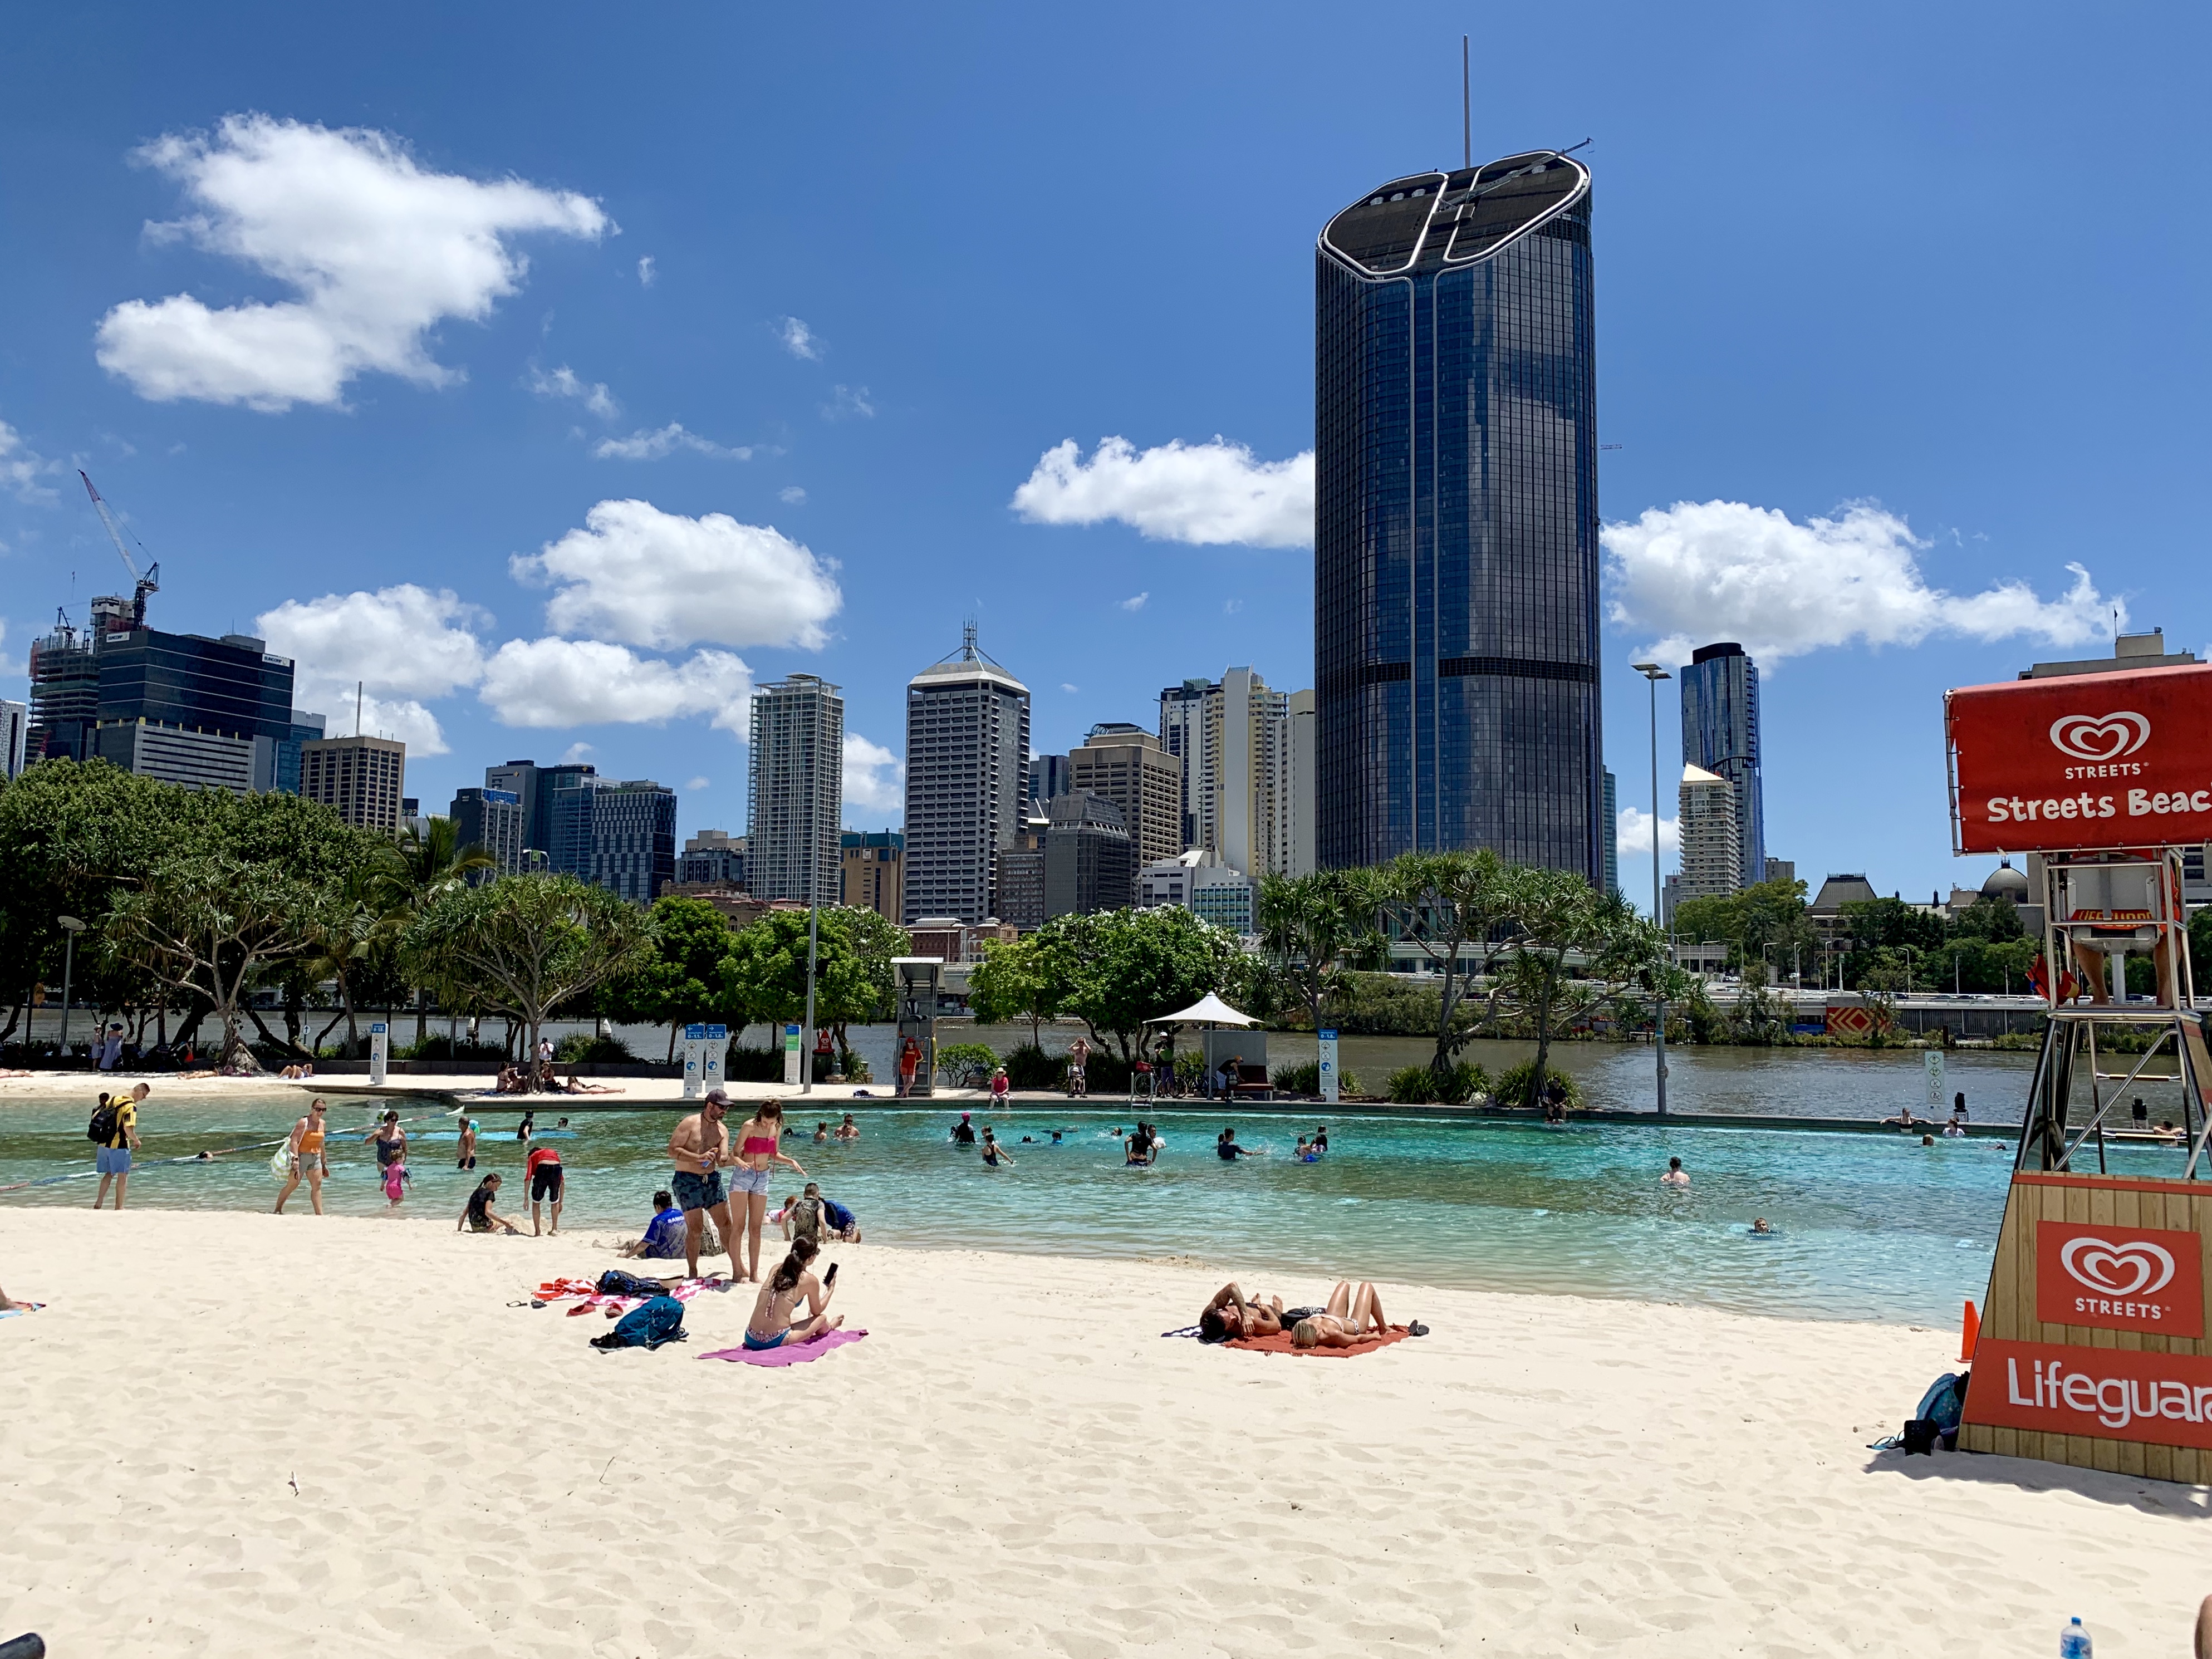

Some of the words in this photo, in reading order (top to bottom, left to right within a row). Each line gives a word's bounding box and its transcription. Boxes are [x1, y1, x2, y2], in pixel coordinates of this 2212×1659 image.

[2064, 763, 2141, 779] STREETS
[1987, 792, 2116, 822] Streets
[2127, 782, 2212, 816] Beac
[2076, 1297, 2162, 1319] STREETS
[2008, 1357, 2212, 1429] Lifeguar
